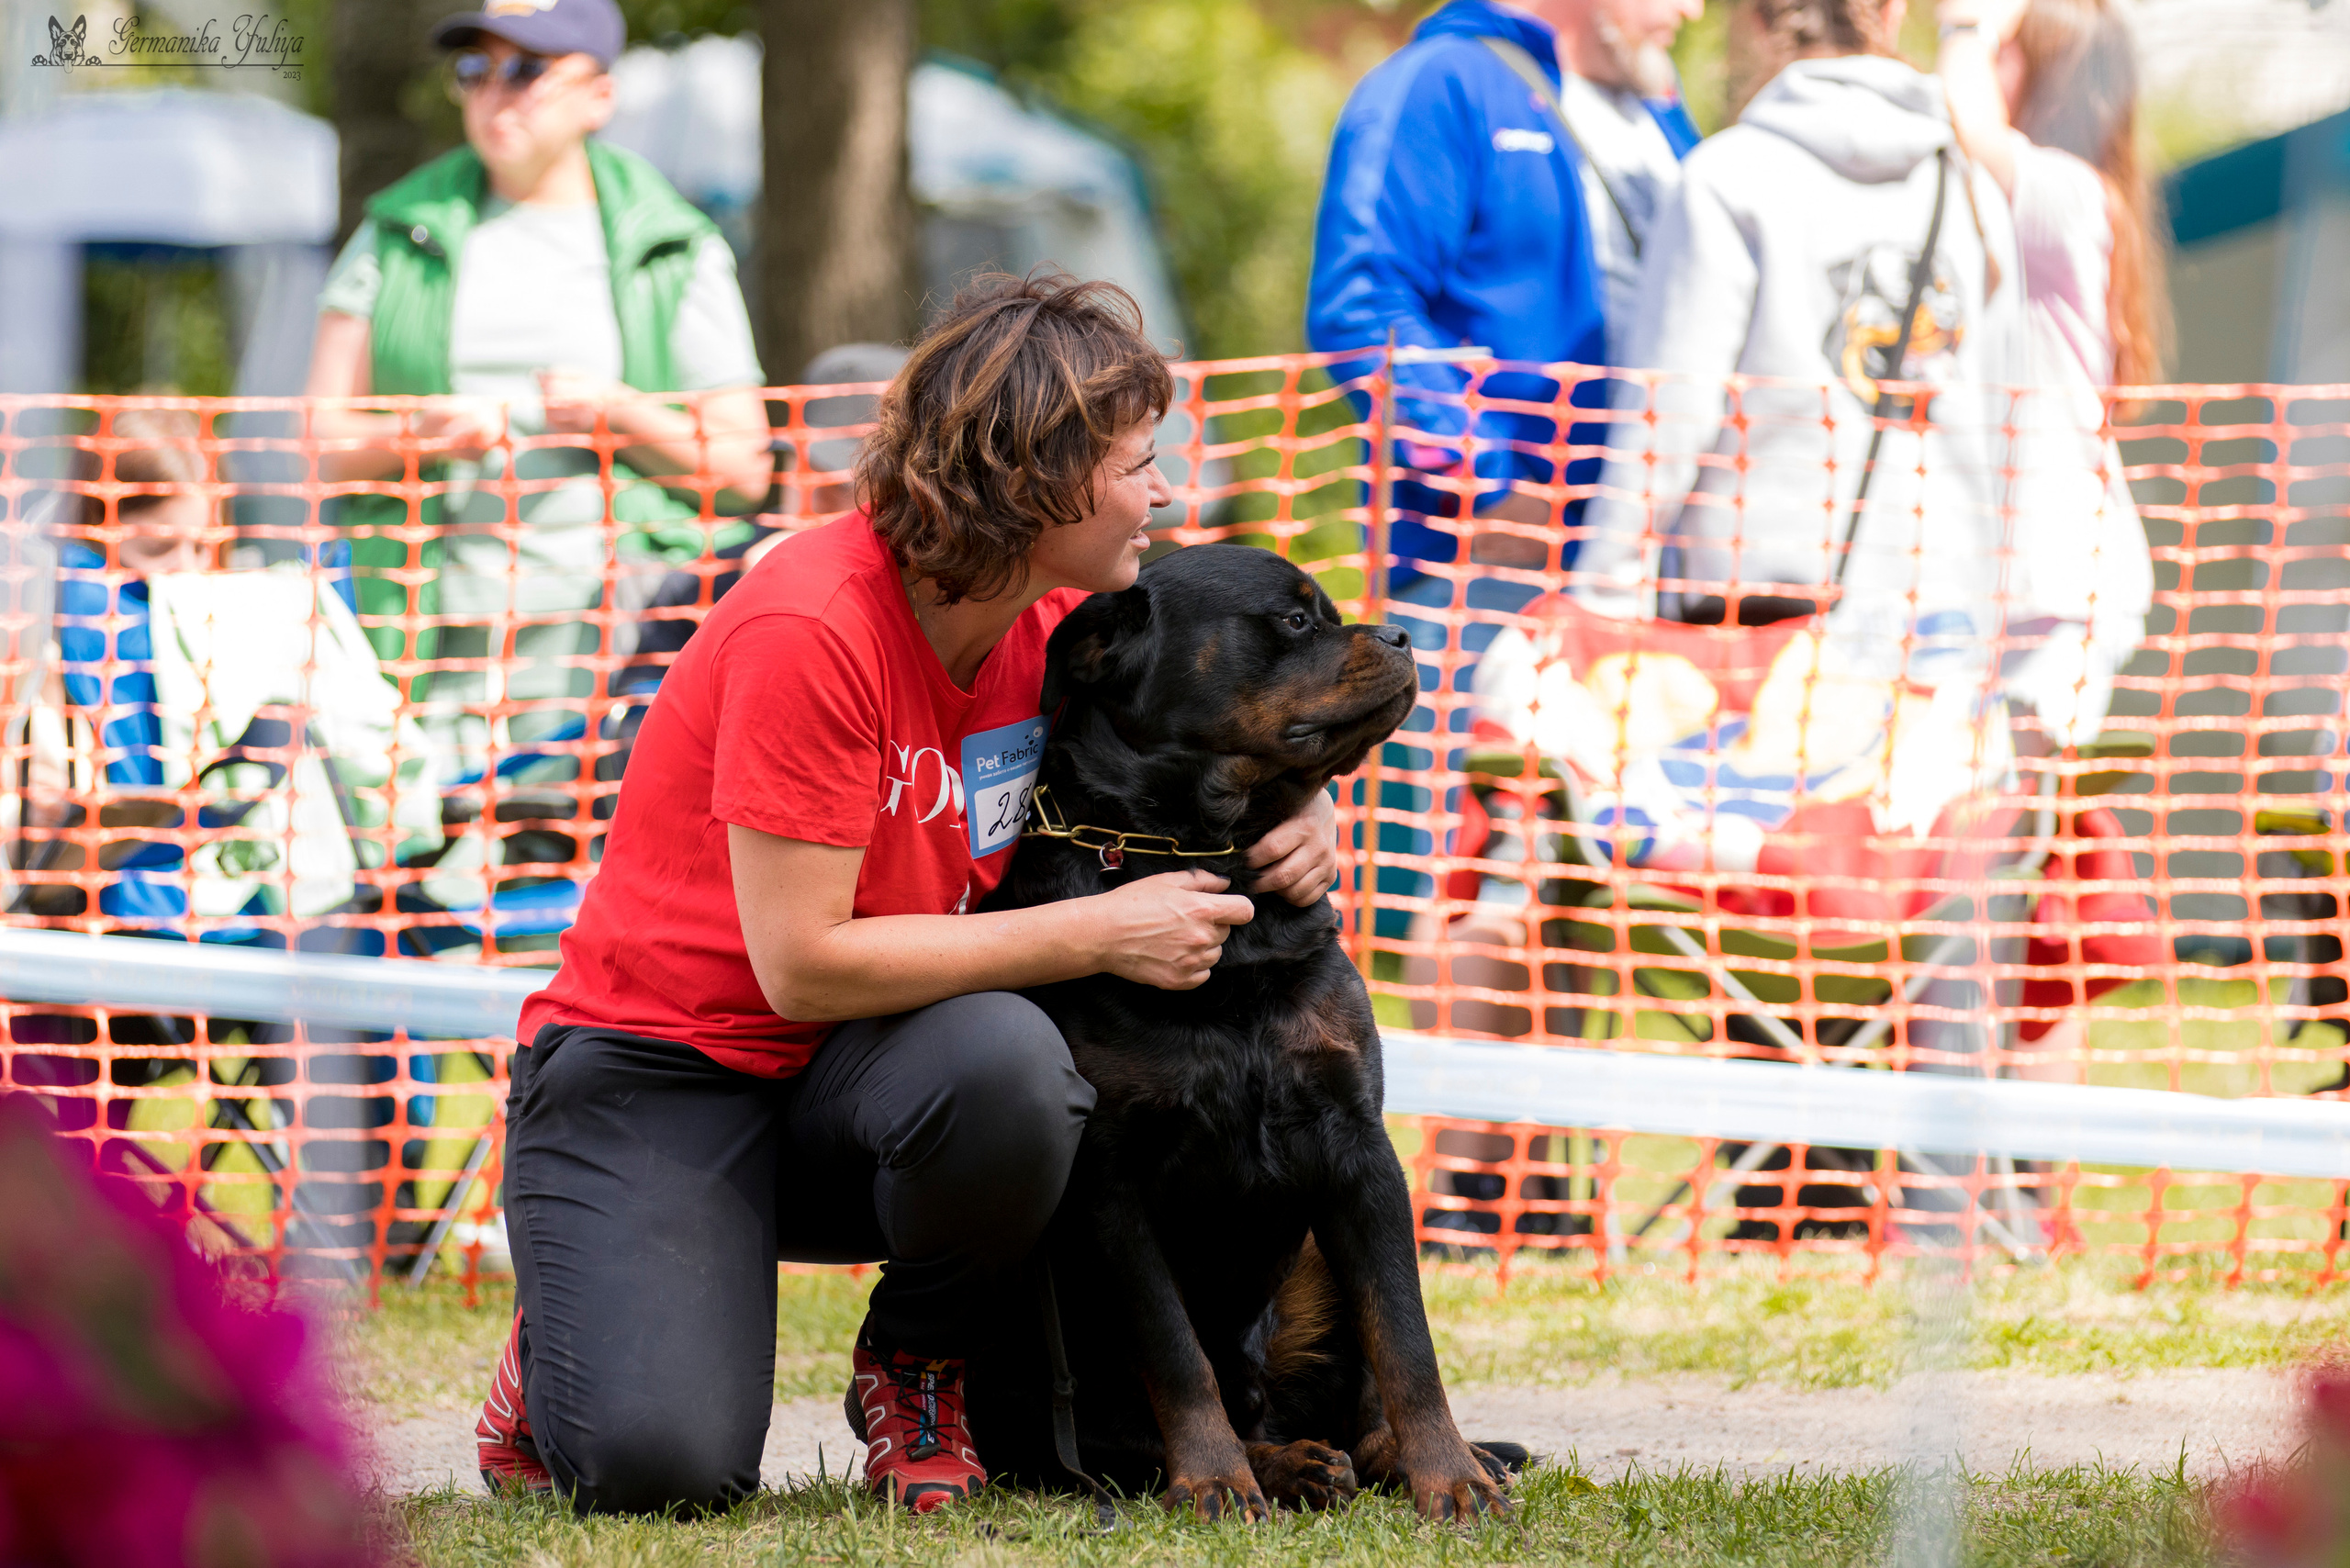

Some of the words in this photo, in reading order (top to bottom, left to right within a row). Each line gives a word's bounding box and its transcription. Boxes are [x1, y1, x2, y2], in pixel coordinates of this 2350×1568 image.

[976, 755, 1001, 773] Pet
[1002, 743, 1039, 766] Fabric
[988, 781, 1033, 837] 28
